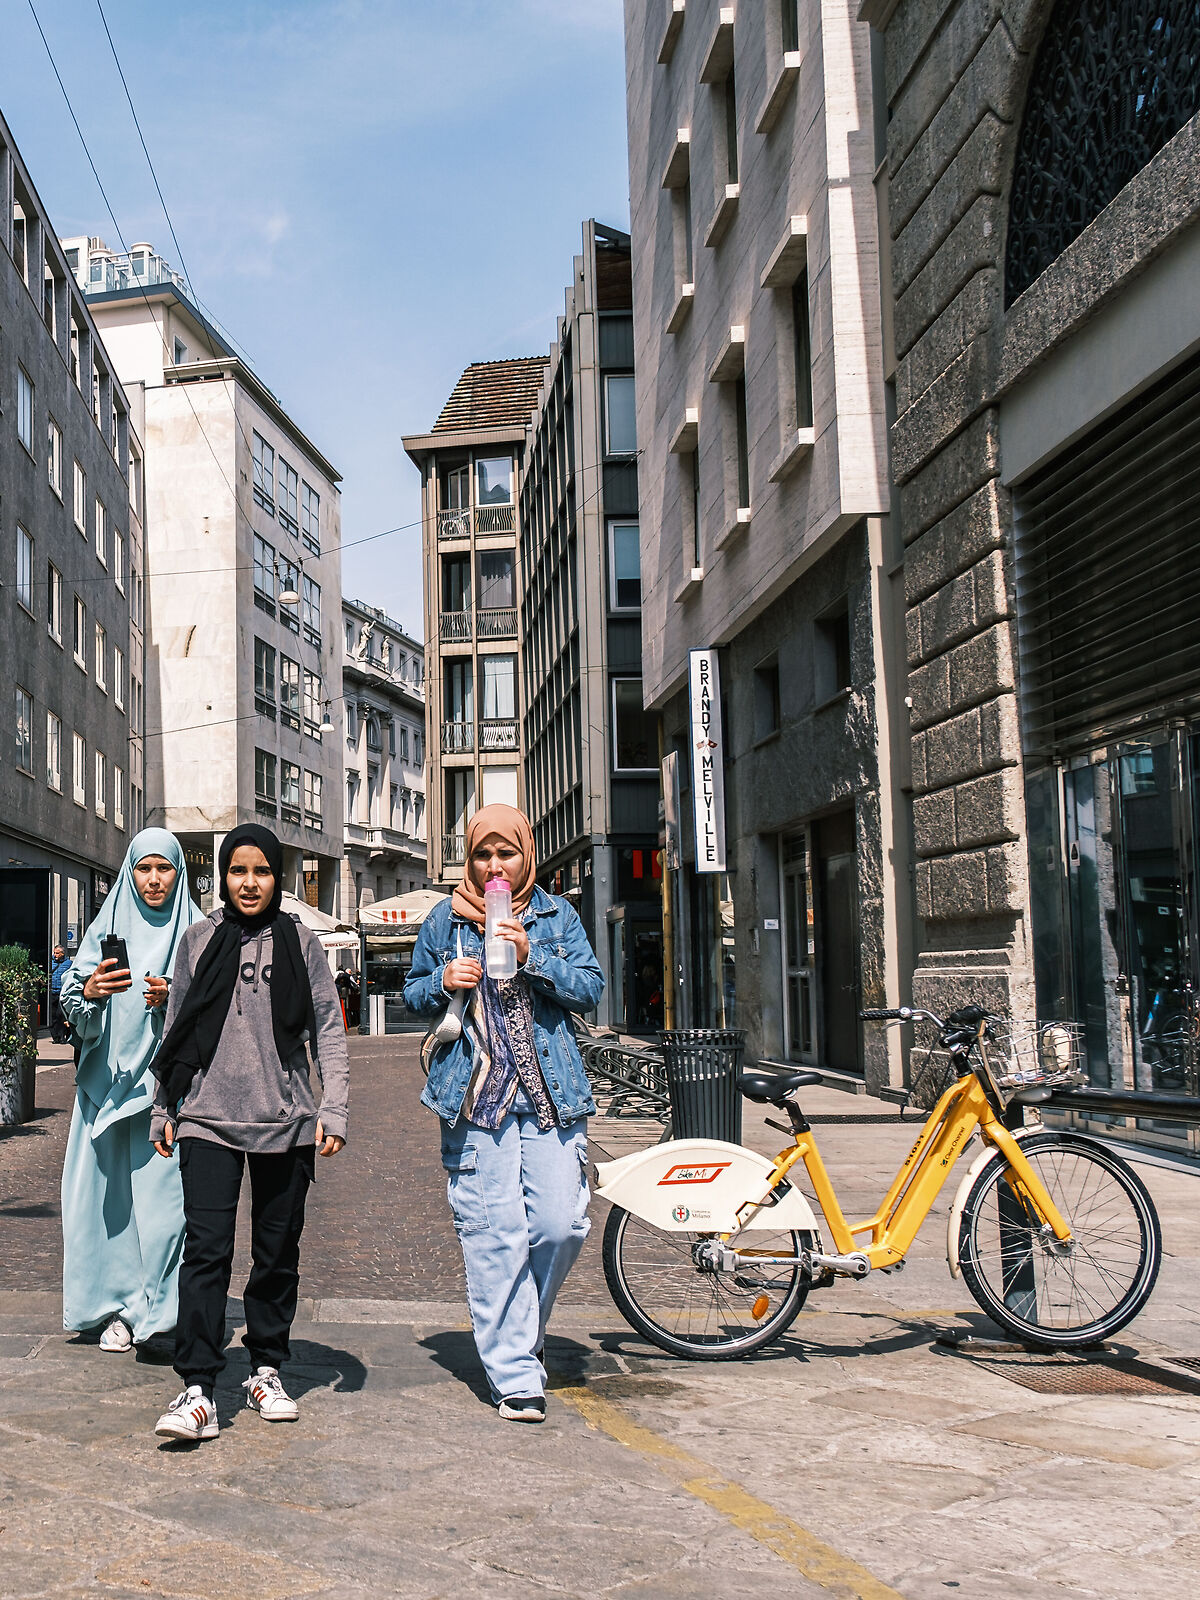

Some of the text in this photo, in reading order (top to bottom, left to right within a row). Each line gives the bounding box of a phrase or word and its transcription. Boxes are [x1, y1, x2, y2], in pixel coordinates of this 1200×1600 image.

[700, 659, 715, 862] BRANDY MELVILLE
[944, 1127, 965, 1160] Clear Channel
